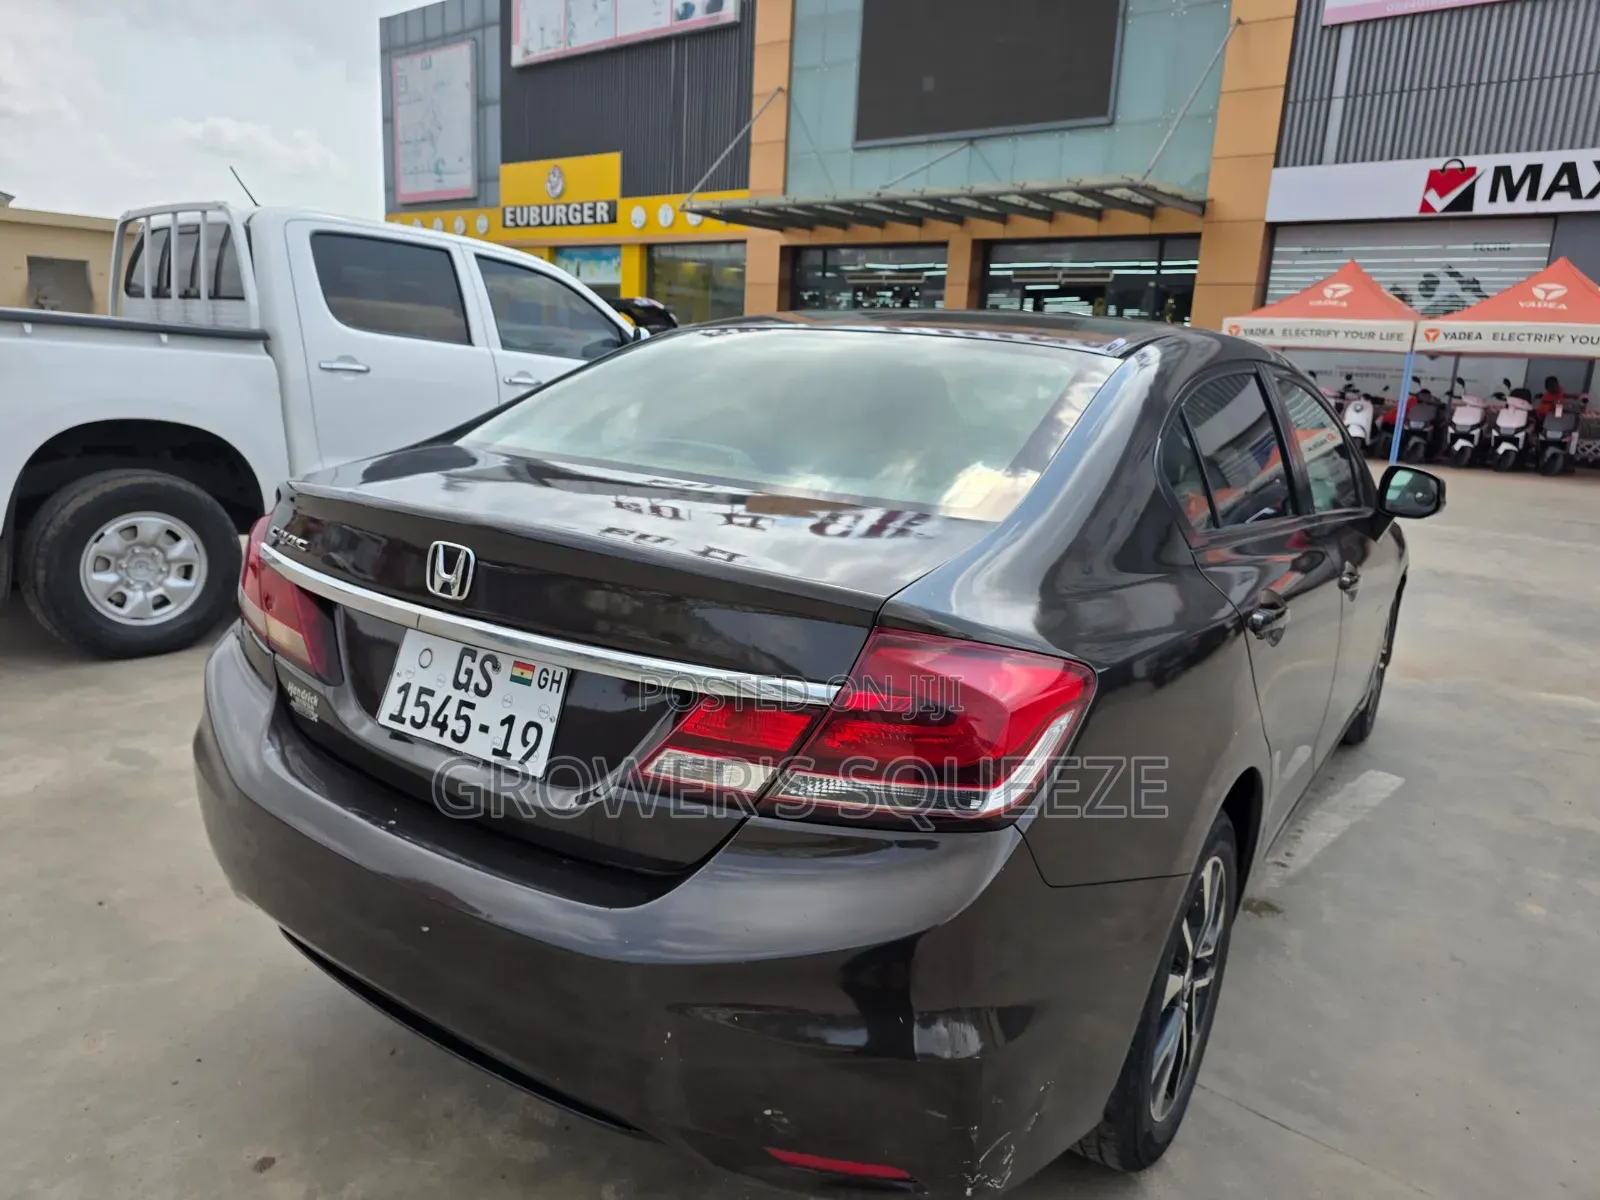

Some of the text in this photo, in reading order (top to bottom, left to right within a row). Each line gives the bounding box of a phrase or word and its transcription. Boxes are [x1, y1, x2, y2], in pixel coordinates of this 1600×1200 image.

[504, 201, 610, 227] EUBURGER
[1243, 327, 1404, 342] YADEA ELECTRIFY YOUR LIFE
[1443, 331, 1483, 341] YADEA
[1492, 331, 1566, 343] ELECTRIFY
[452, 647, 564, 698] GS GH
[388, 681, 544, 765] 1545-19
